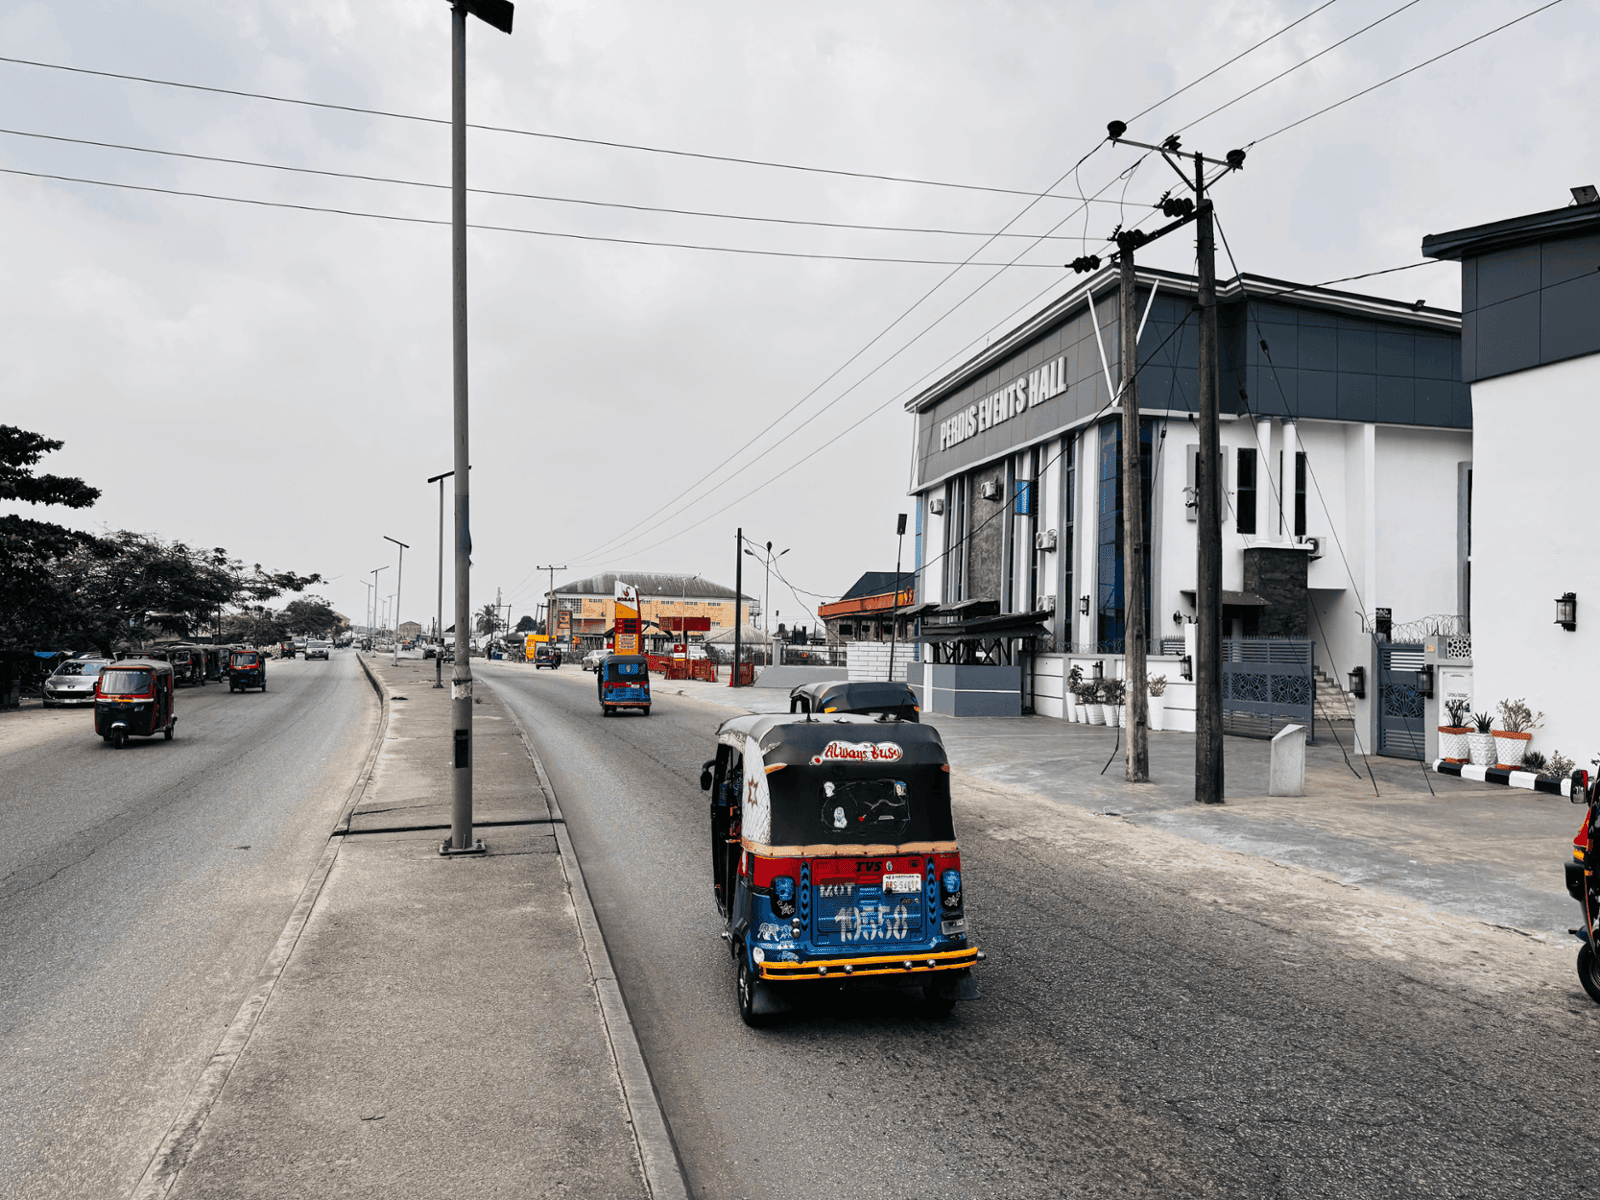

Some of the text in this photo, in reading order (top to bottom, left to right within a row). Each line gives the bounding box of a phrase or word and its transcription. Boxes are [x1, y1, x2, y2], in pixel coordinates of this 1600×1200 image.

[940, 356, 1068, 451] PERDIS EVENTS HALL
[825, 742, 867, 765] Always
[856, 861, 882, 872] TVS
